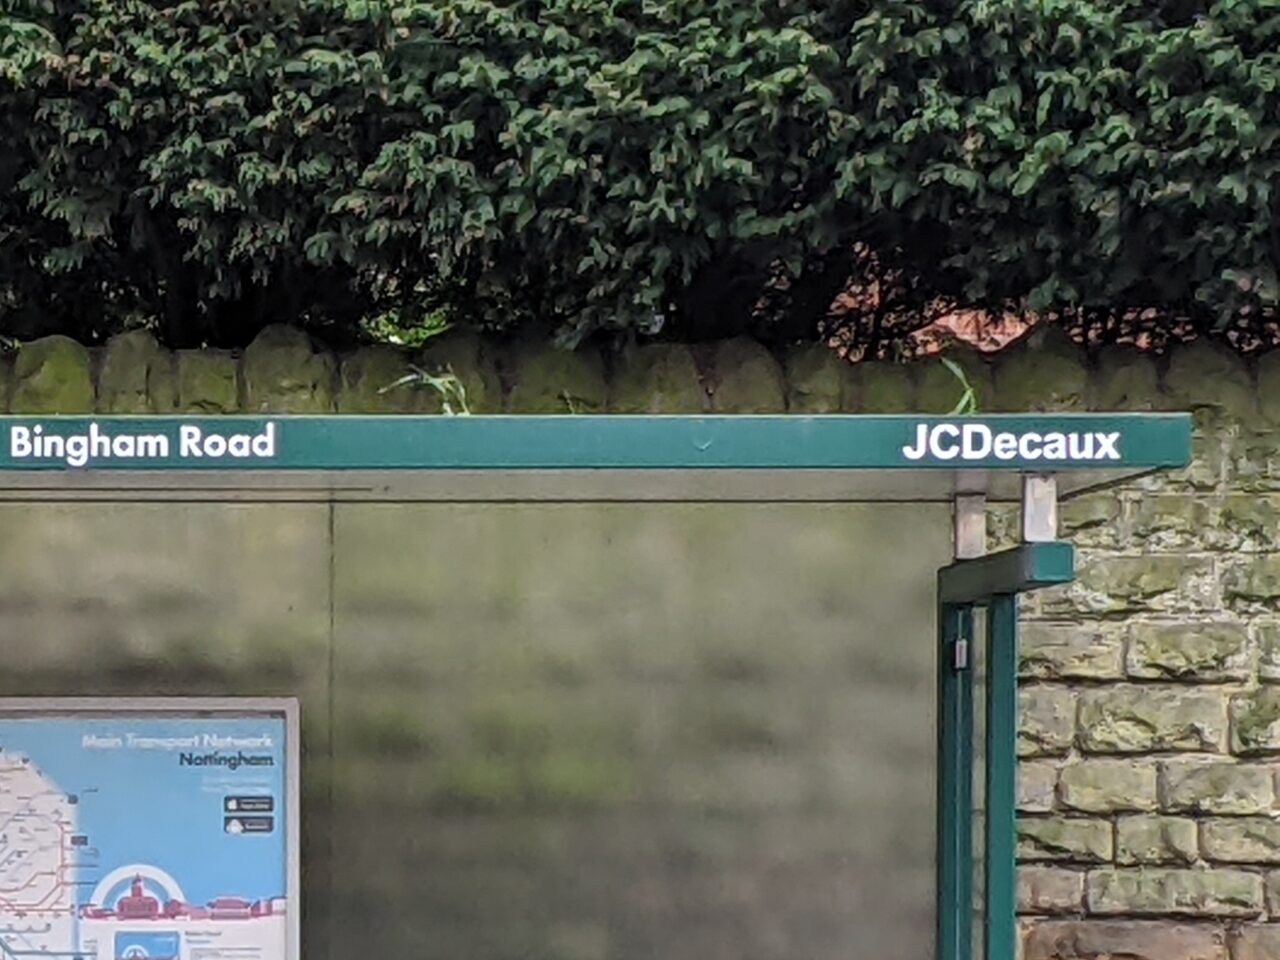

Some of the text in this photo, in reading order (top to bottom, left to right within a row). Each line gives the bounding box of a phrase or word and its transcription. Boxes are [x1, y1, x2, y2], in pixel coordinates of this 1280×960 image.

[10, 423, 276, 467] Bingham Road
[902, 423, 1121, 460] JCDecaux
[82, 732, 274, 751] Main Transport Network
[179, 751, 274, 770] Nottingham
